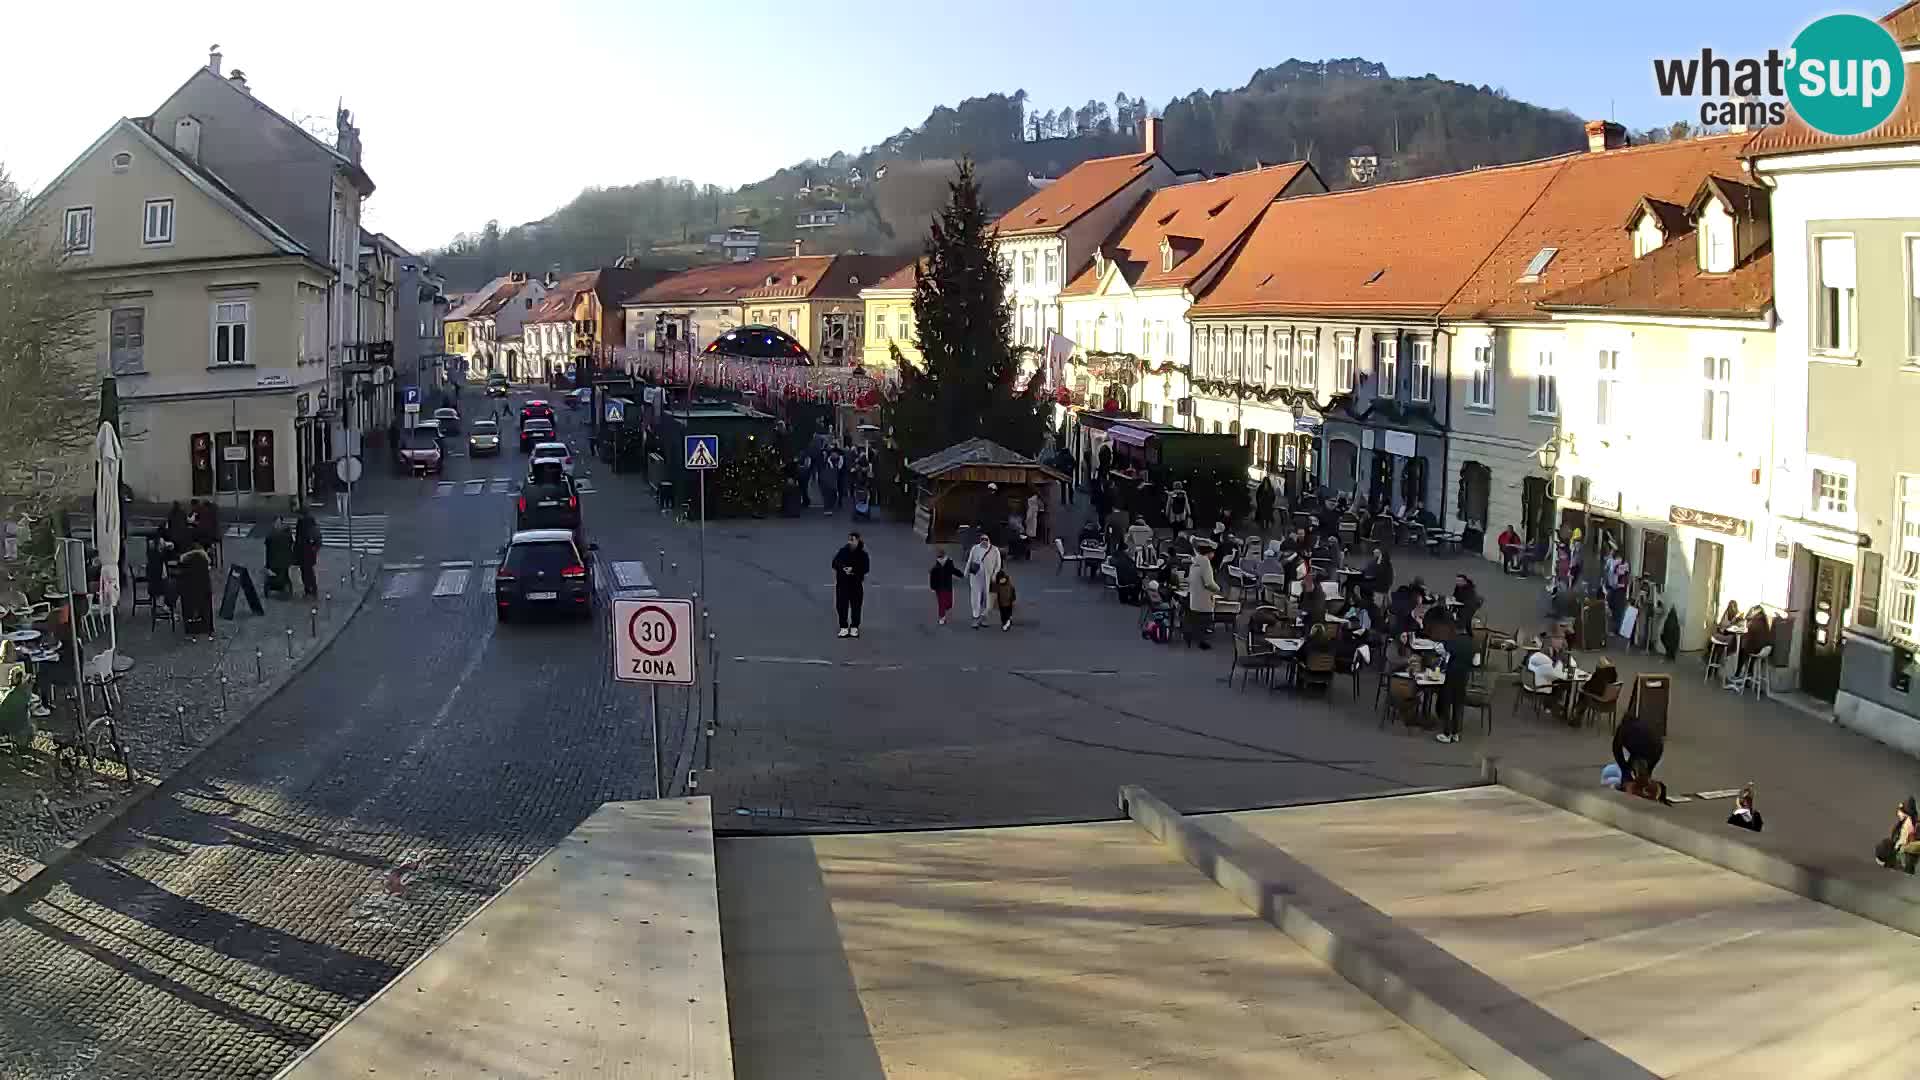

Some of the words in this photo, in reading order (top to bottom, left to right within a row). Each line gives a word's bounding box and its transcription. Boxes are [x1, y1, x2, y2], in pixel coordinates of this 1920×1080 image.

[408, 390, 417, 401] P
[641, 621, 665, 642] 30
[631, 658, 676, 676] ZONA
